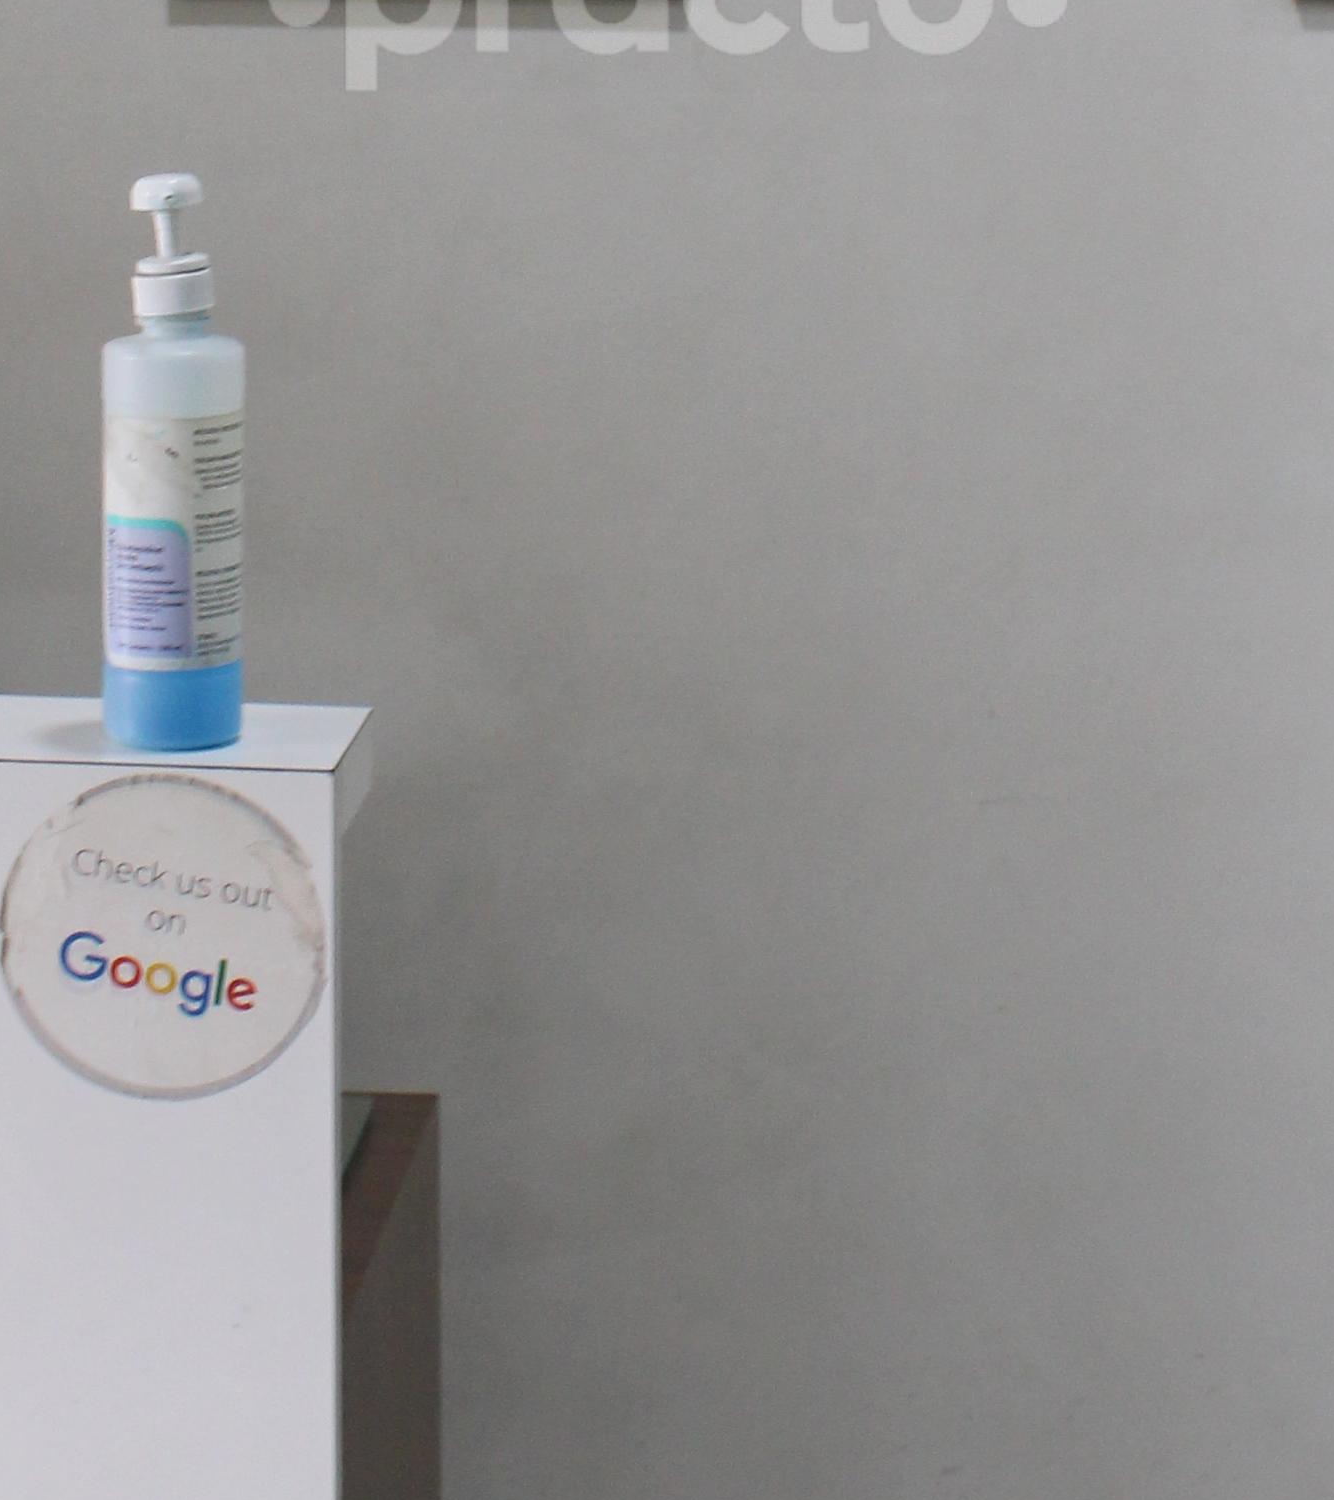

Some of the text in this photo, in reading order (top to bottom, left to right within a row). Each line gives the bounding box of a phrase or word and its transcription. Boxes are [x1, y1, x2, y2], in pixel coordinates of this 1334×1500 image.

[72, 848, 275, 911] Check us out
[144, 909, 188, 936] on
[59, 930, 258, 1017] Google
